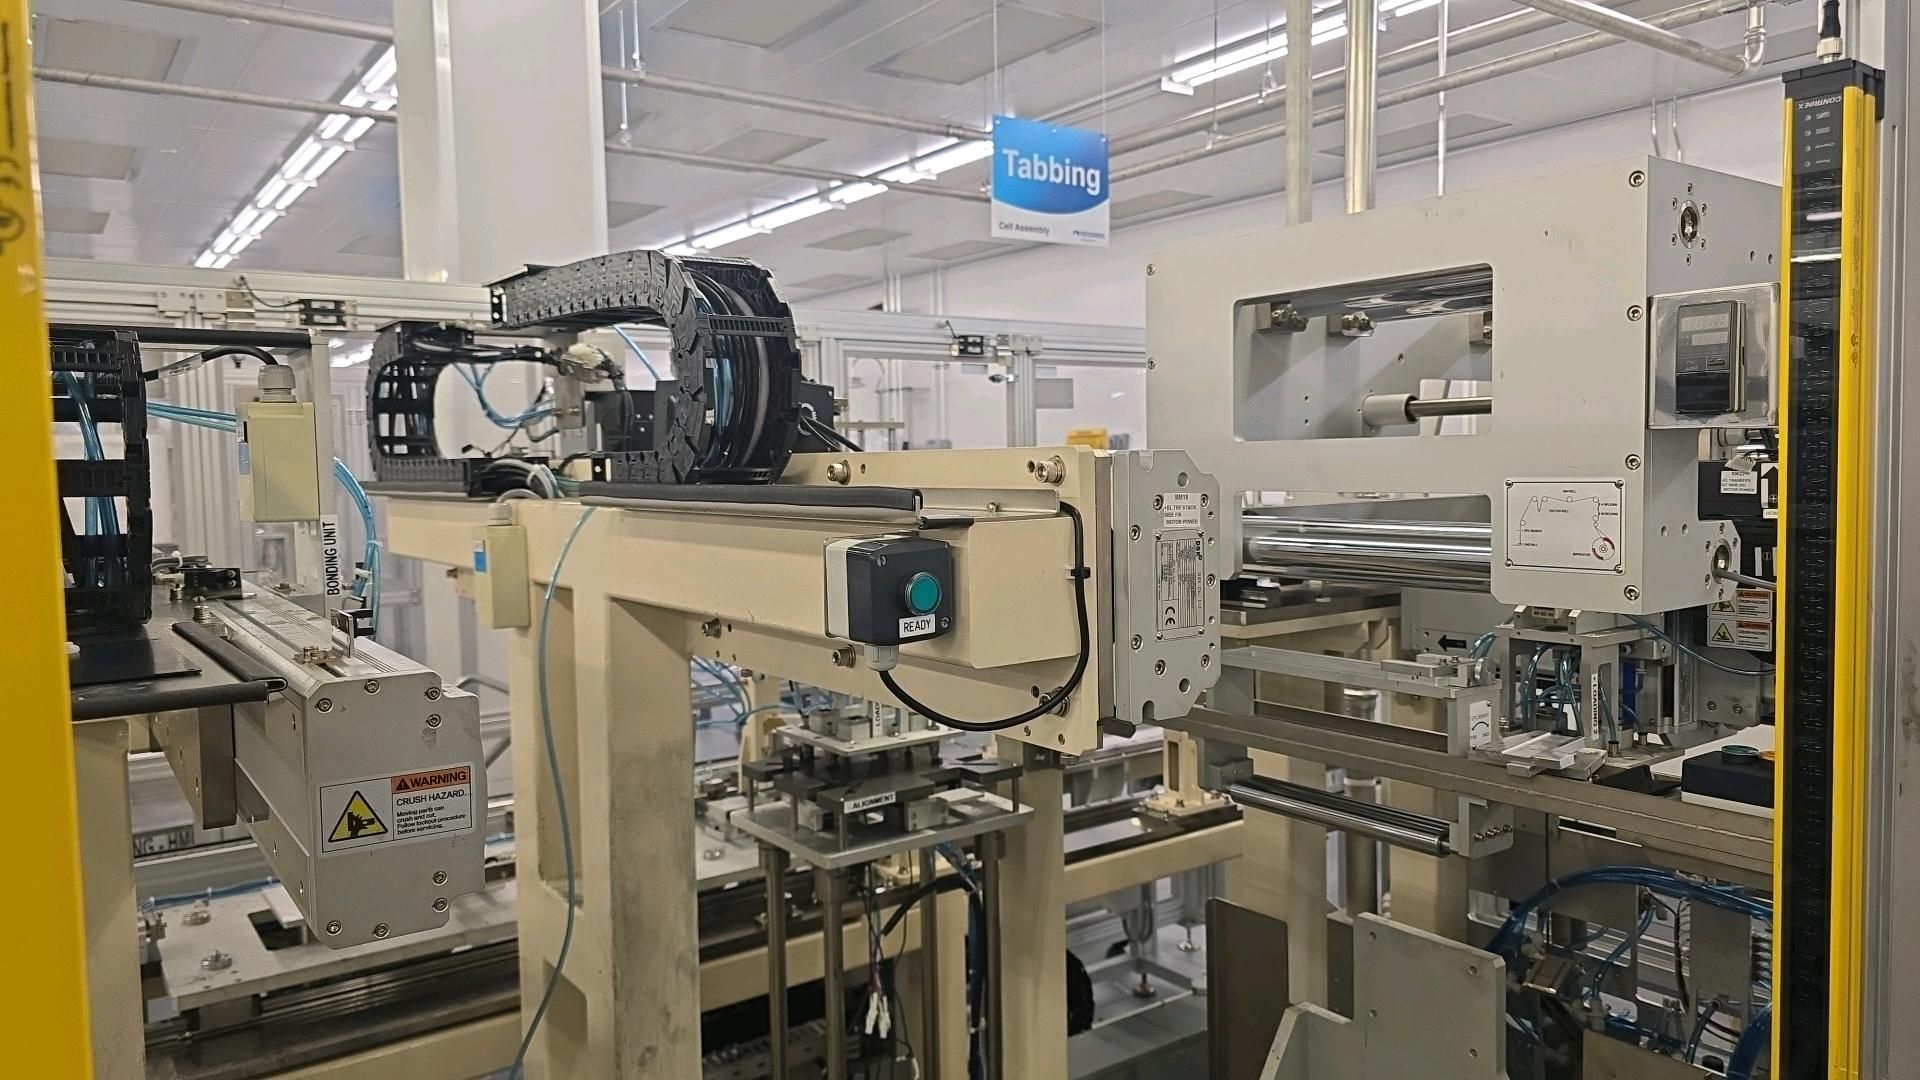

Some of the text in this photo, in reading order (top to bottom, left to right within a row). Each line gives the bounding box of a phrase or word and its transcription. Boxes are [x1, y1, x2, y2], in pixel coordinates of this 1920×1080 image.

[1798, 96, 1841, 110] CONTRINEX
[1002, 149, 1101, 196] Tabbing
[998, 222, 1050, 236] Cell Assembly
[323, 522, 340, 596] BONDING UNIT
[903, 619, 931, 633] READY
[410, 771, 467, 788] WARNING
[396, 789, 467, 806] CRUSH HAZARD.
[853, 794, 894, 809] ALIGNMENT
[397, 809, 418, 817] Moving
[416, 818, 437, 826] lockout
[437, 814, 466, 823] procedure
[417, 824, 444, 832] servicing.
